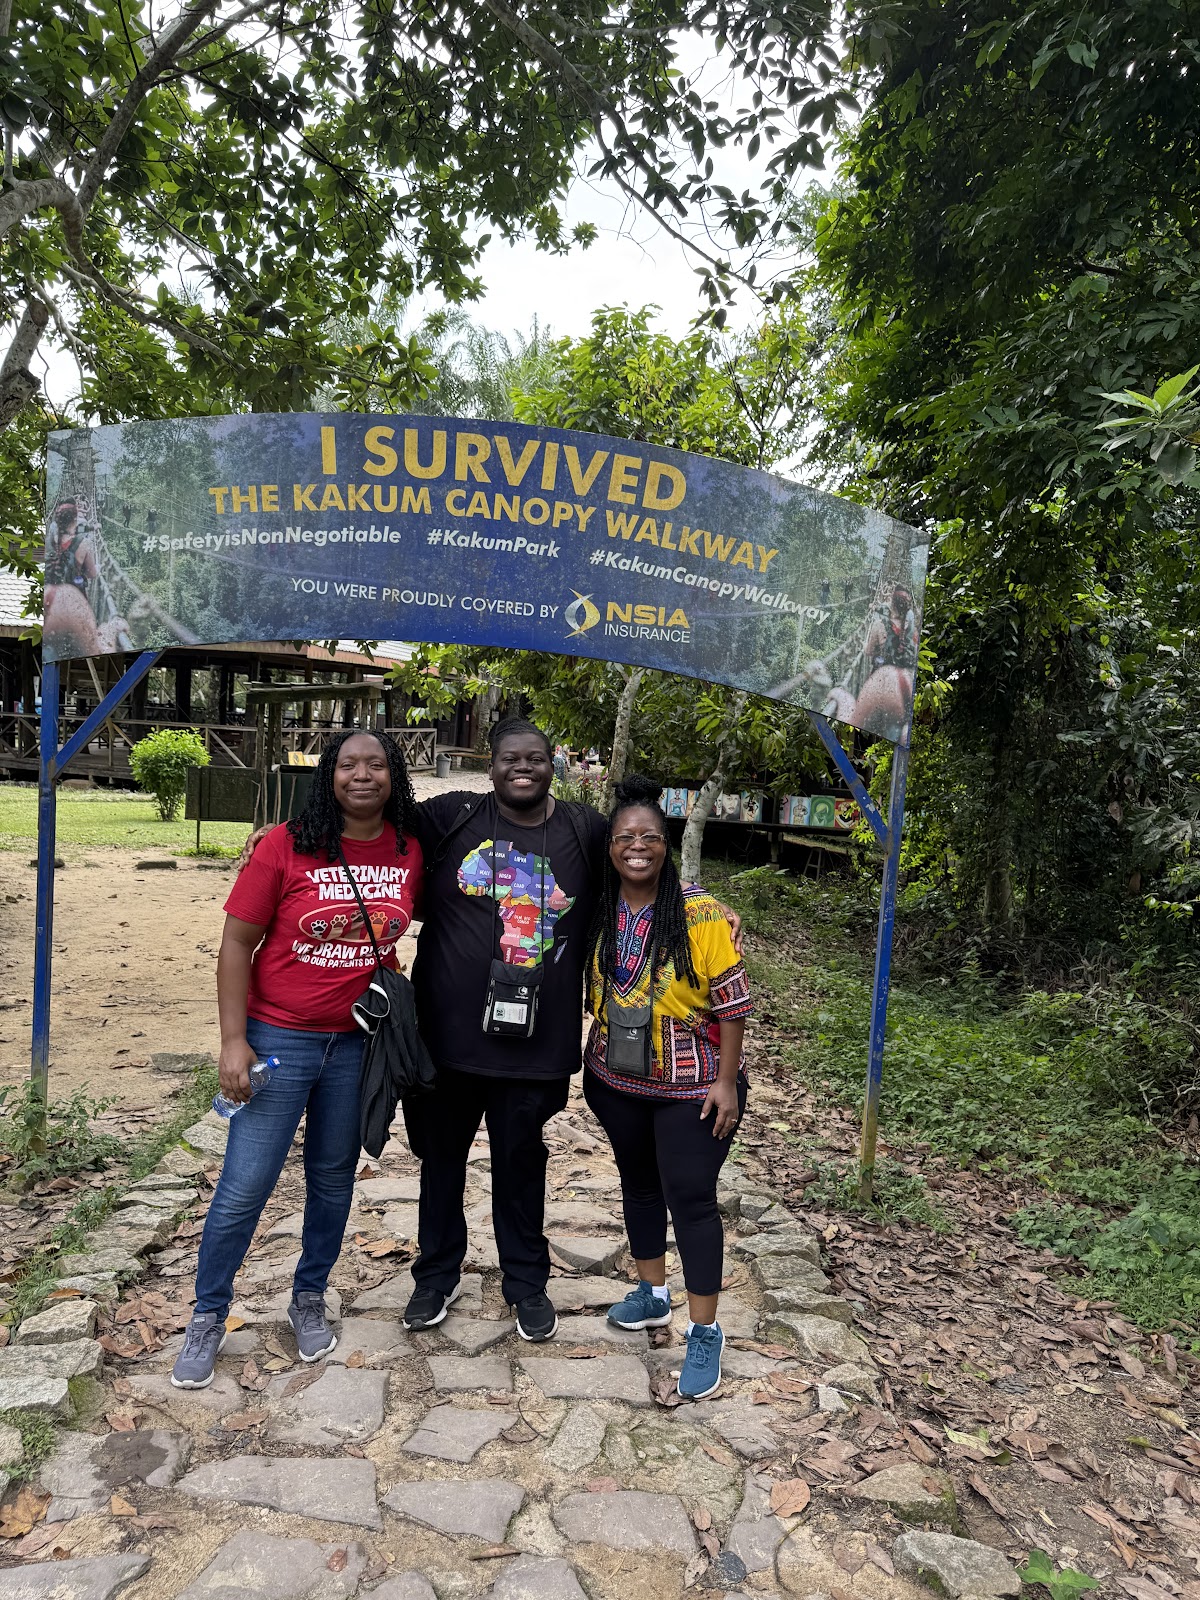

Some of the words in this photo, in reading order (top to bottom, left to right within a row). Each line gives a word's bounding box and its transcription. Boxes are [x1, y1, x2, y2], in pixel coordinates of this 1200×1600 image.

[321, 426, 338, 475] I
[362, 426, 687, 512] SURVIVED
[208, 485, 280, 515] THE
[294, 484, 432, 515] KAKUM
[445, 489, 597, 532] CANOPY
[606, 510, 779, 573] WALKWAY
[142, 525, 402, 553] #SafetyisNonNegotiable
[426, 527, 560, 558] #KakumPark
[589, 548, 831, 626] #KakumCanopyWalkway
[291, 578, 329, 595] YOU
[334, 582, 377, 601] WERE
[382, 588, 457, 609] PROUDLY
[460, 596, 534, 617] COVERED
[539, 603, 559, 619] BY
[606, 601, 690, 629] NSIA
[604, 622, 691, 644] INSURANCE
[305, 865, 410, 884] VETERINARY
[319, 883, 402, 900] MEDICINE
[311, 955, 327, 968] OUR
[313, 942, 358, 960] DRAW
